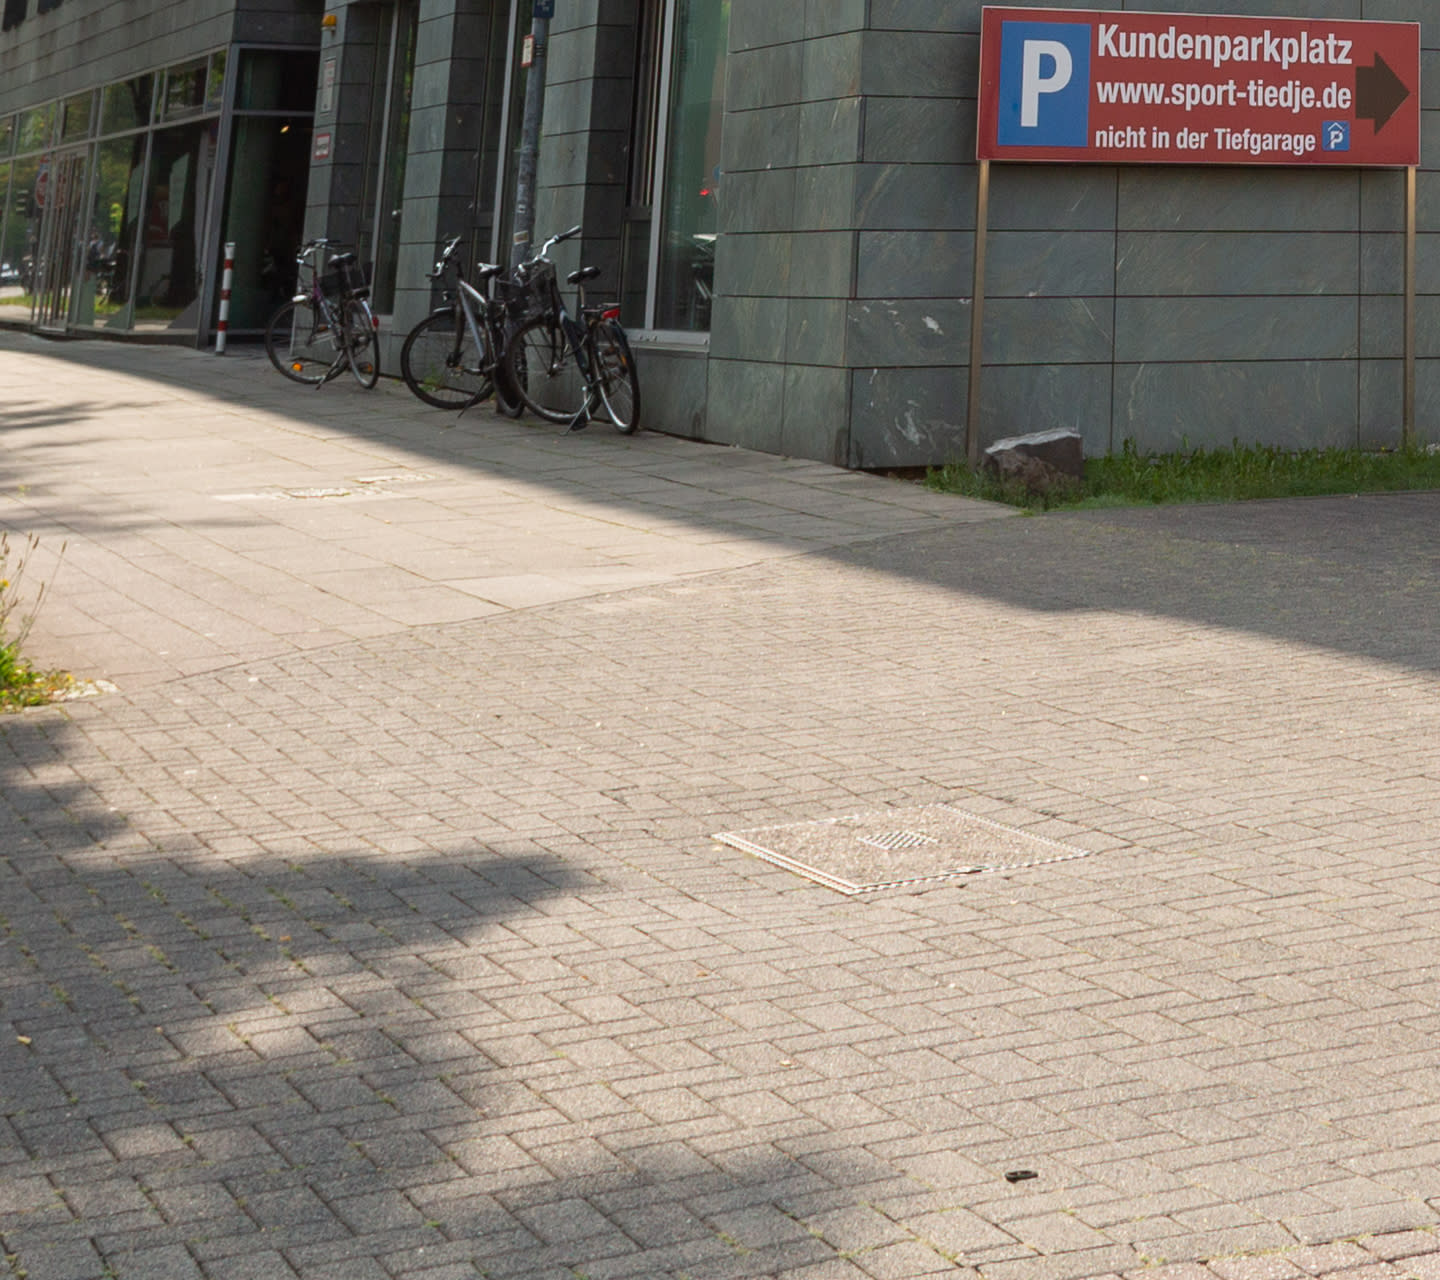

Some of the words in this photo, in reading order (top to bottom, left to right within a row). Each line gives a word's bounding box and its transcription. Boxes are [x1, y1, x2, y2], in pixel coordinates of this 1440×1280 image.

[1097, 23, 1353, 70] Kundenparkplatz
[1020, 39, 1073, 127] P
[1096, 78, 1352, 114] www.sport-tiedje.de
[1095, 125, 1147, 149] nicht
[1151, 127, 1171, 149] in
[1176, 127, 1209, 150] der
[1214, 127, 1316, 155] Tiefgarage
